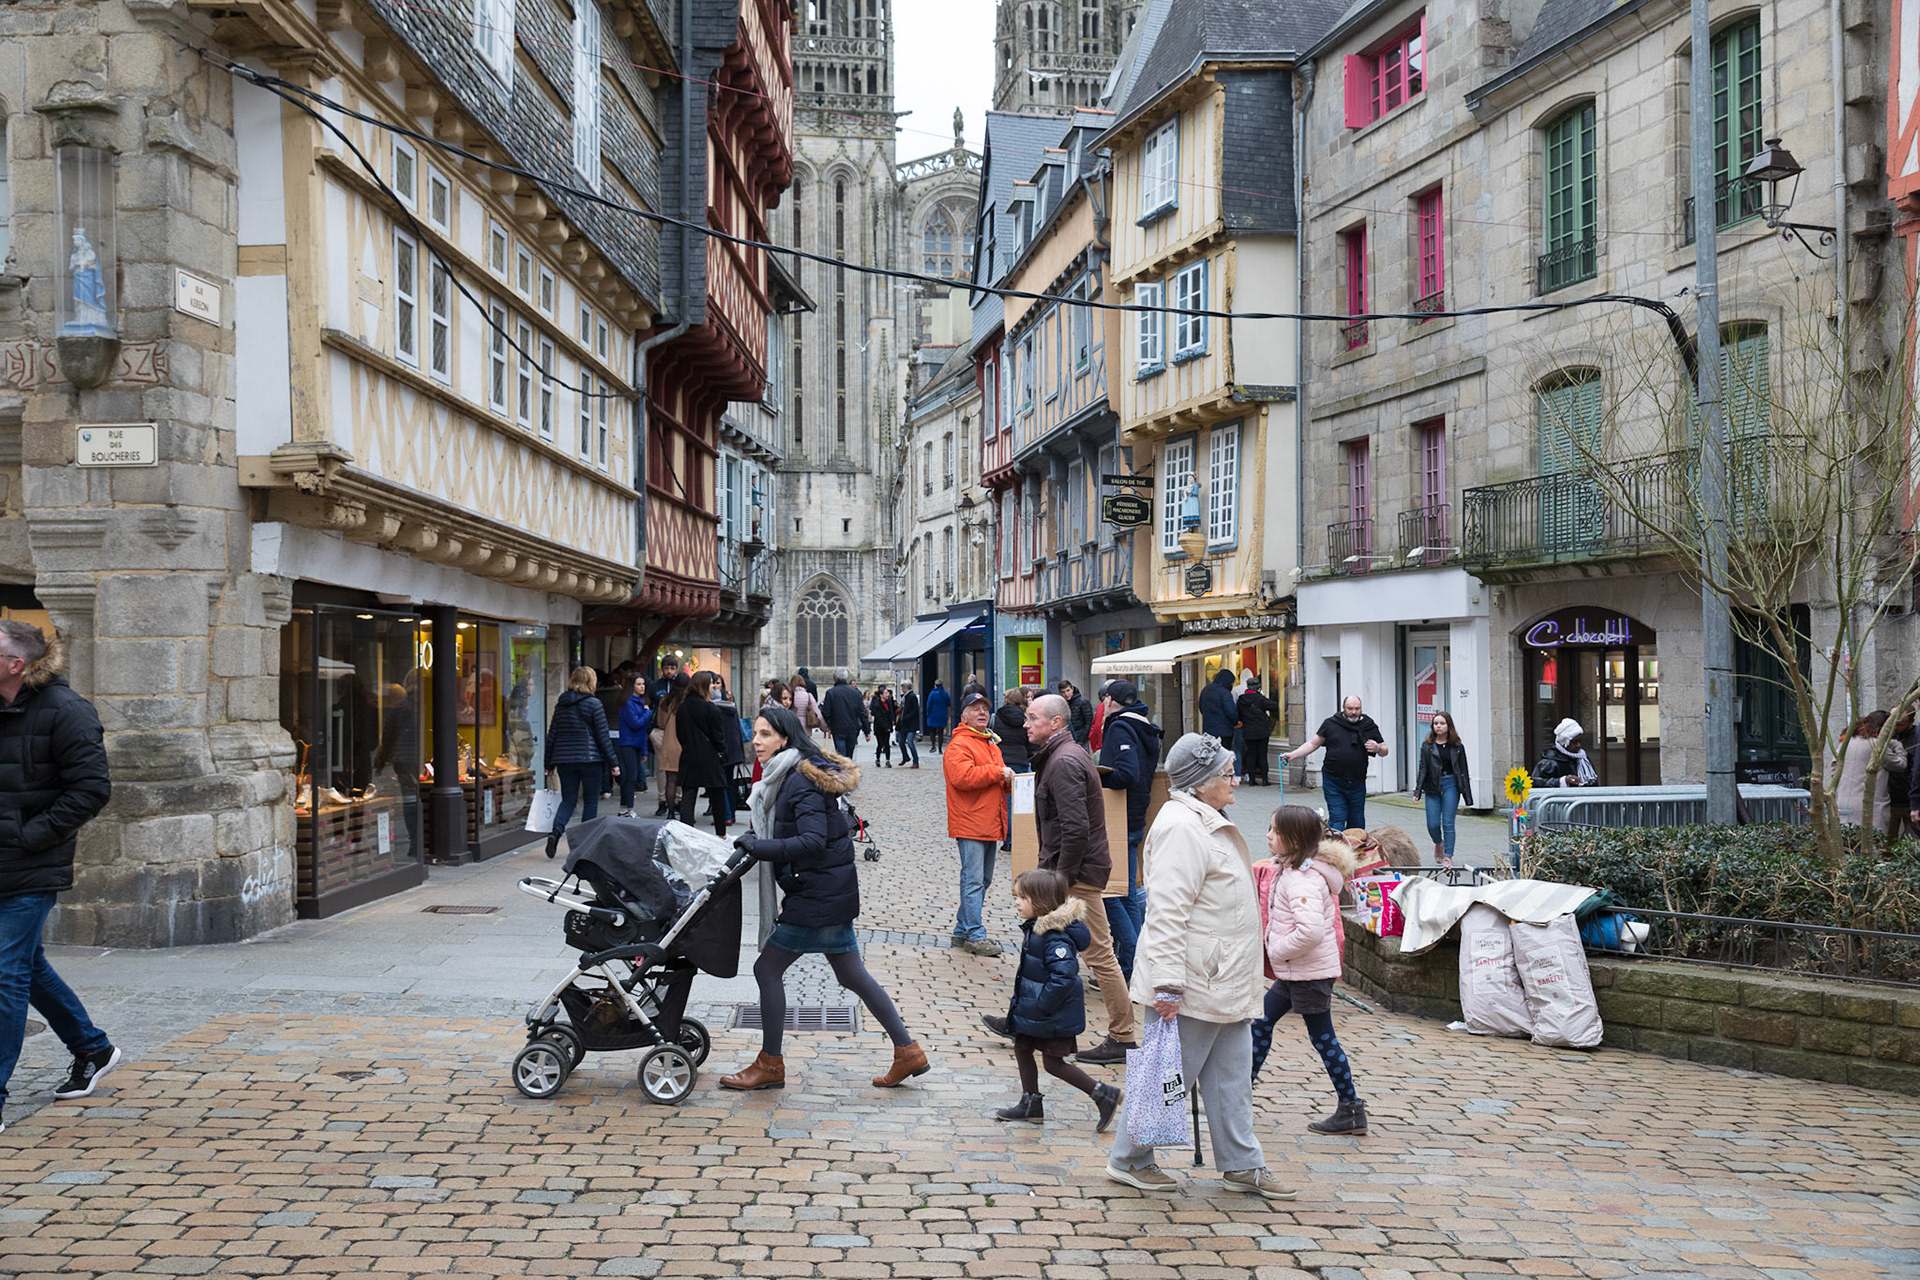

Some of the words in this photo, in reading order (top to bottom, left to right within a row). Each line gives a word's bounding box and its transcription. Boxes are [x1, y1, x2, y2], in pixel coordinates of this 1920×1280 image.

[109, 431, 124, 439] RUE
[91, 451, 141, 462] BOUCHERIES
[1182, 614, 1287, 633] MACARONERIE
